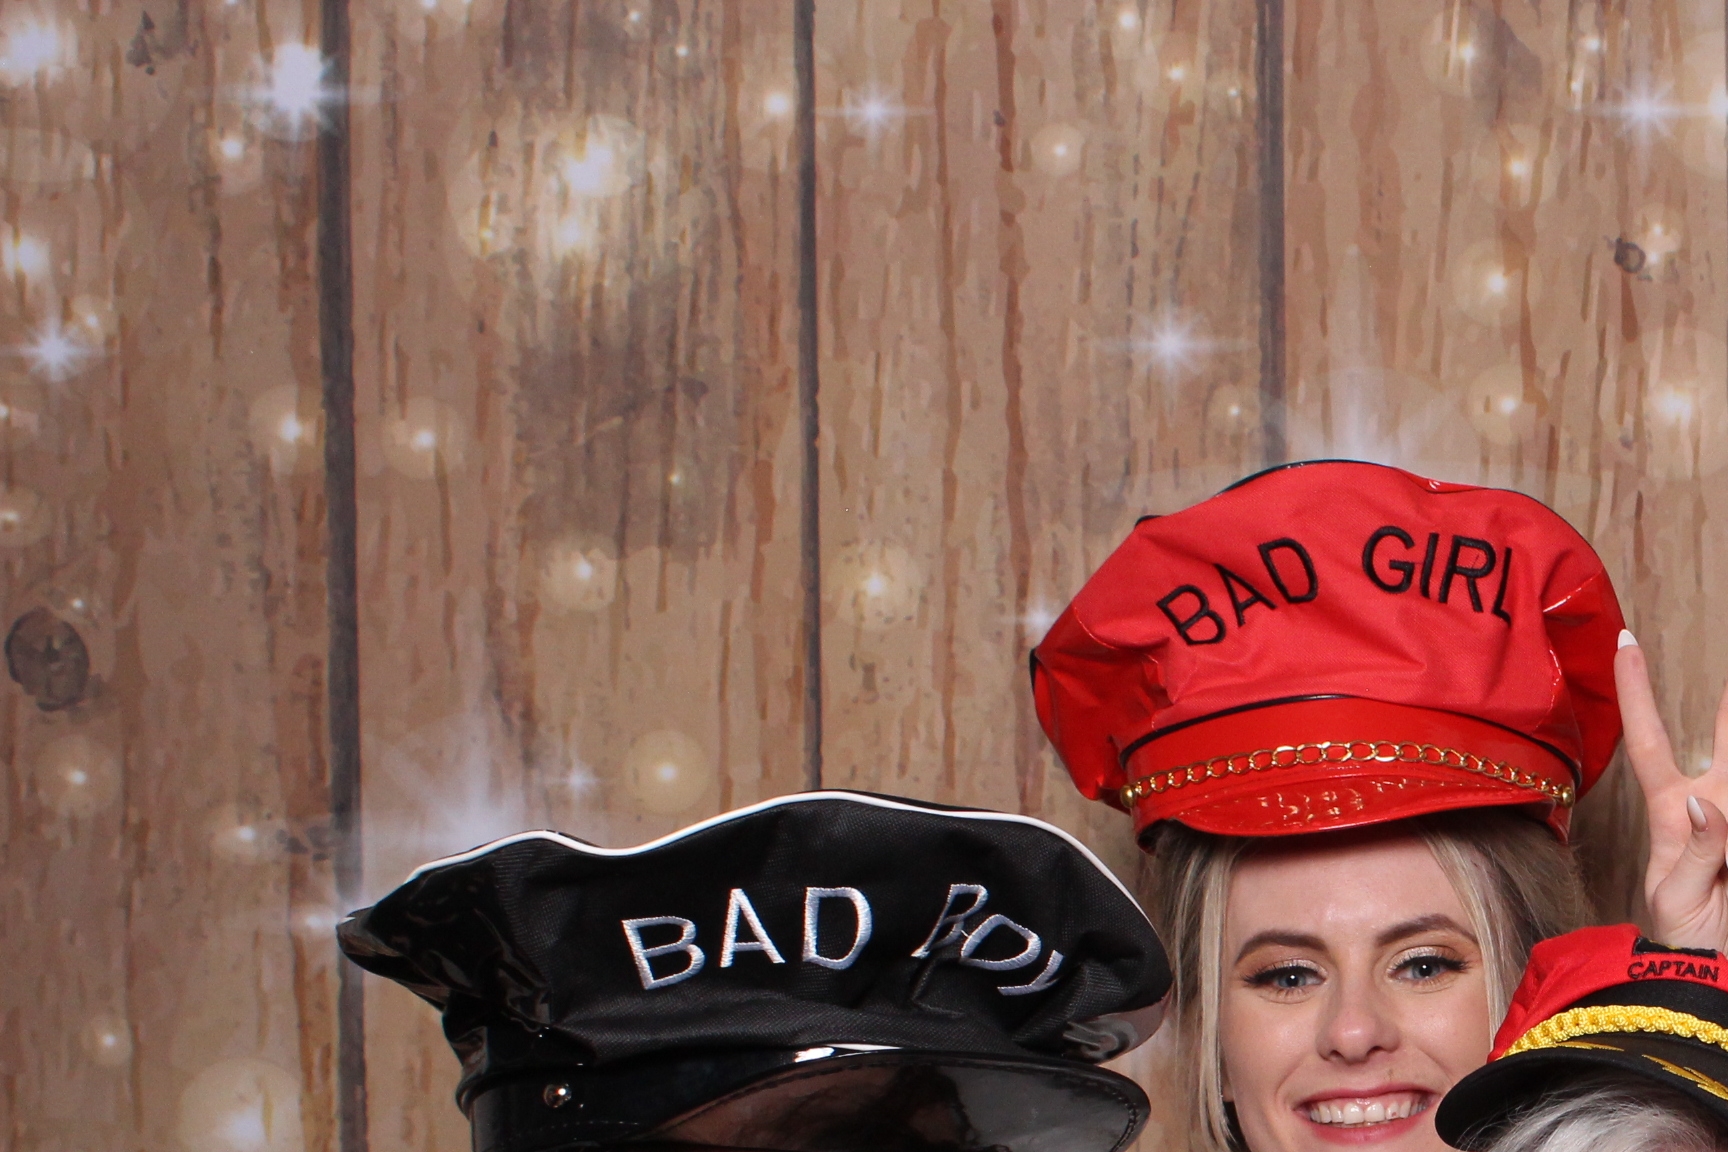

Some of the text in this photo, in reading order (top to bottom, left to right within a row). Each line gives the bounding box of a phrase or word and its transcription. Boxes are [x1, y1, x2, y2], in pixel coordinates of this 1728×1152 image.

[1156, 524, 1513, 647] BAD GIRL
[621, 885, 873, 990] BAD
[1627, 961, 1719, 983] CAPTAIN
